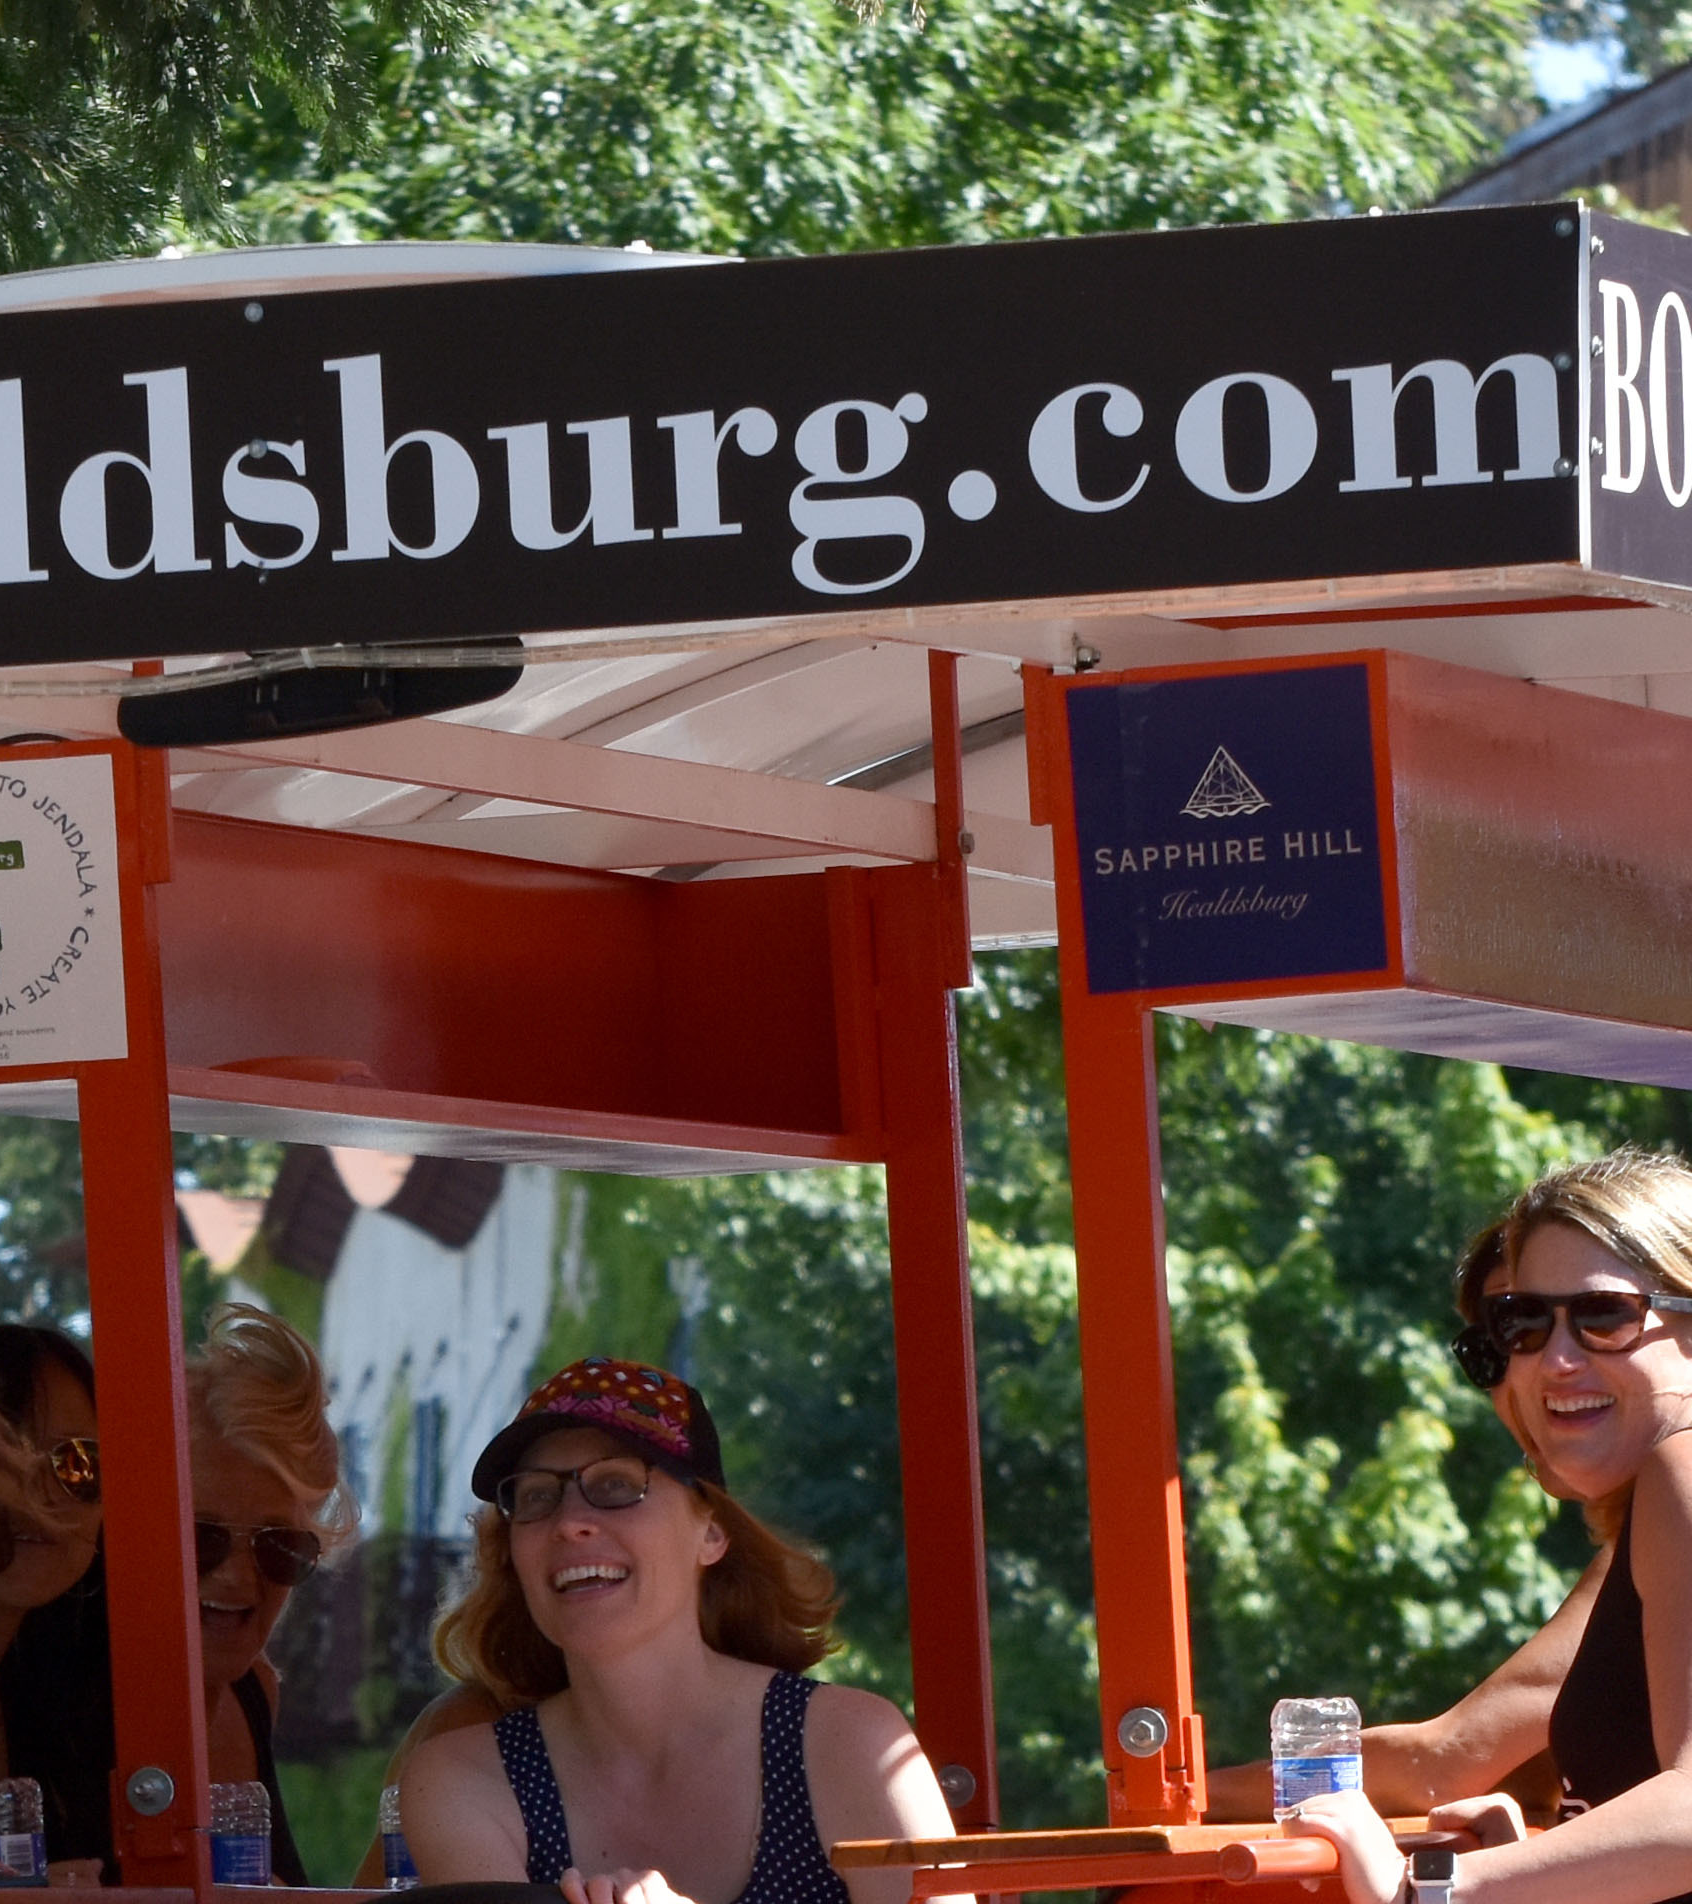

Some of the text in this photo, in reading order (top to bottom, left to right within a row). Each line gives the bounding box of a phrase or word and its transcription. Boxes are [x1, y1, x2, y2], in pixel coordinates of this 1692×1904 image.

[33, 796, 97, 898] JENDALA
[1095, 829, 1362, 875] SAPPHIRE HILL
[1158, 885, 1308, 920] Healdsburg
[21, 926, 89, 1004] CREATE
